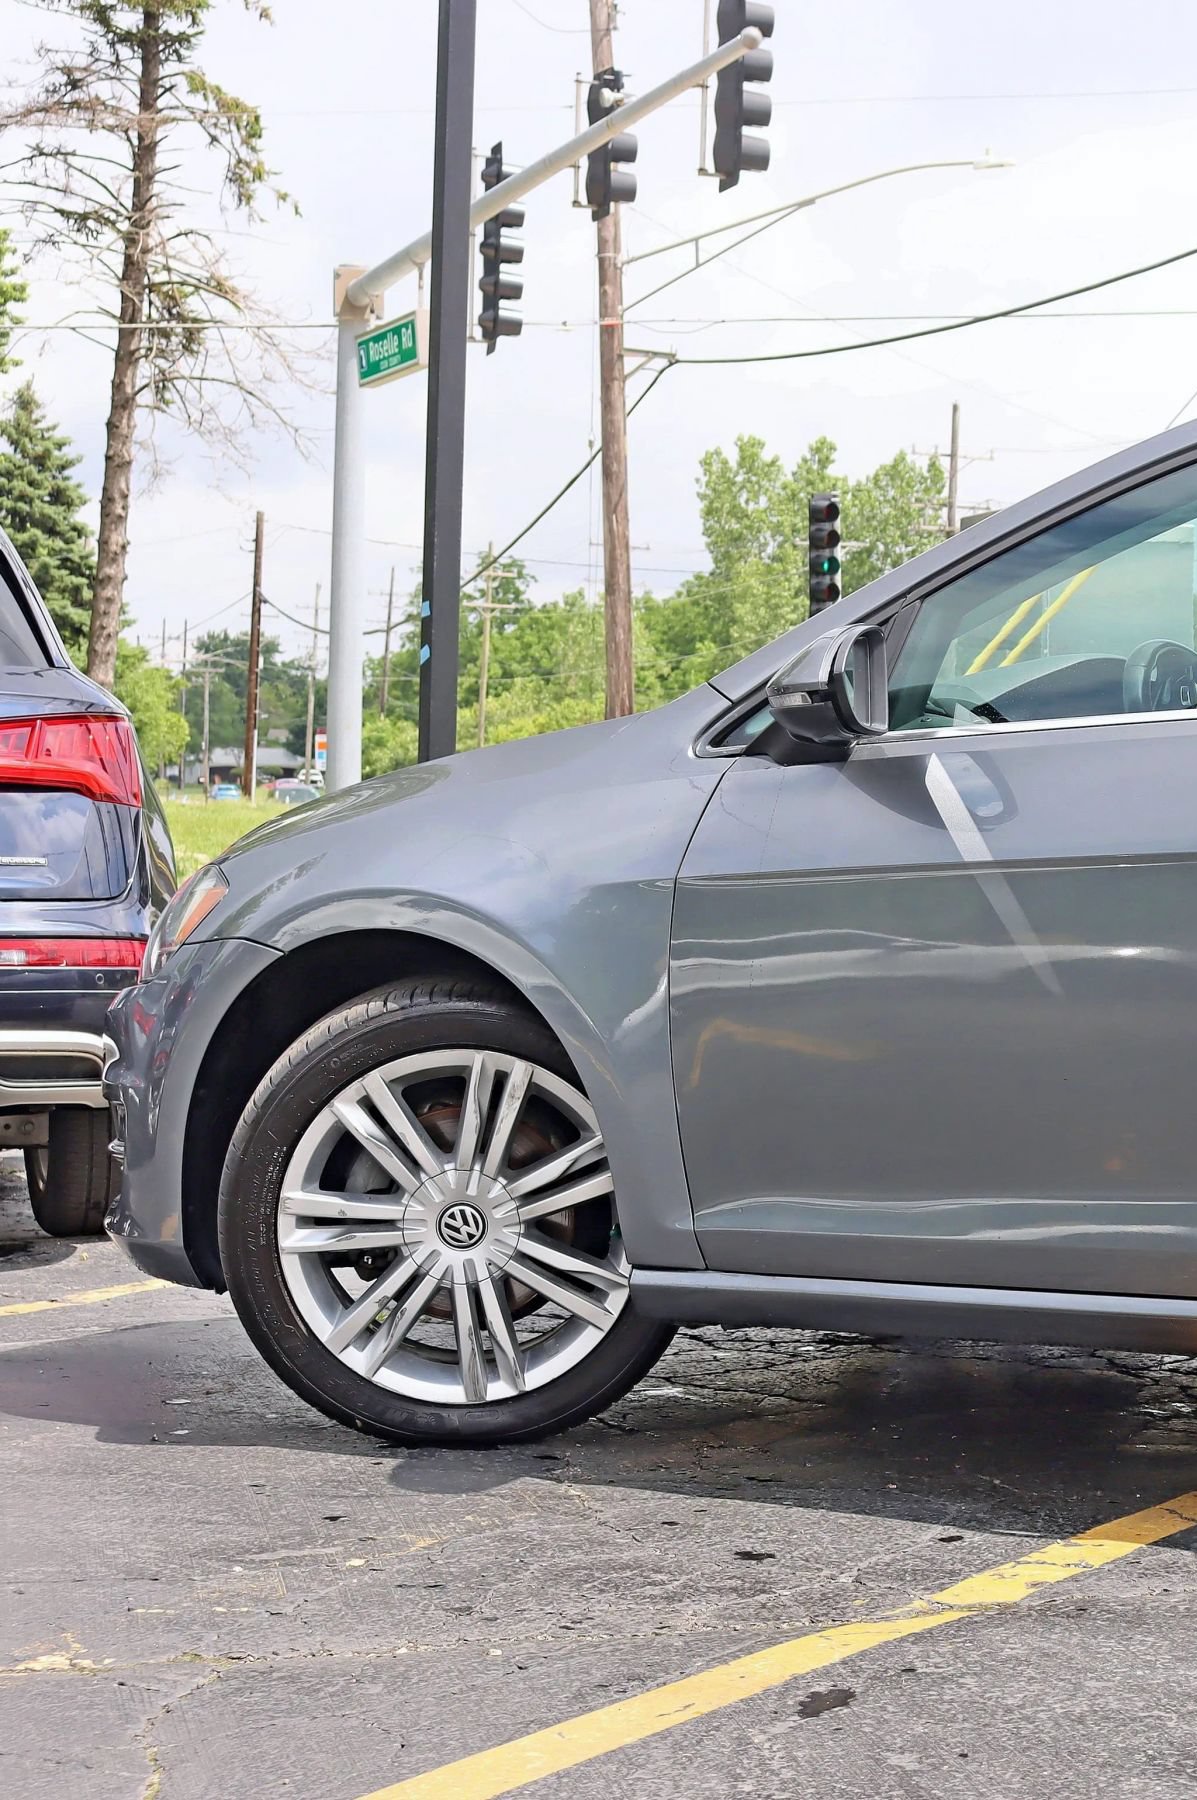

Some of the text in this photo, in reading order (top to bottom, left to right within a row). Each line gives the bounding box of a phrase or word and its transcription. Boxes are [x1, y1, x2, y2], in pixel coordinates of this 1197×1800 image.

[369, 332, 399, 362] Roselle
[401, 323, 412, 349] Rd
[439, 1203, 485, 1248] VW
